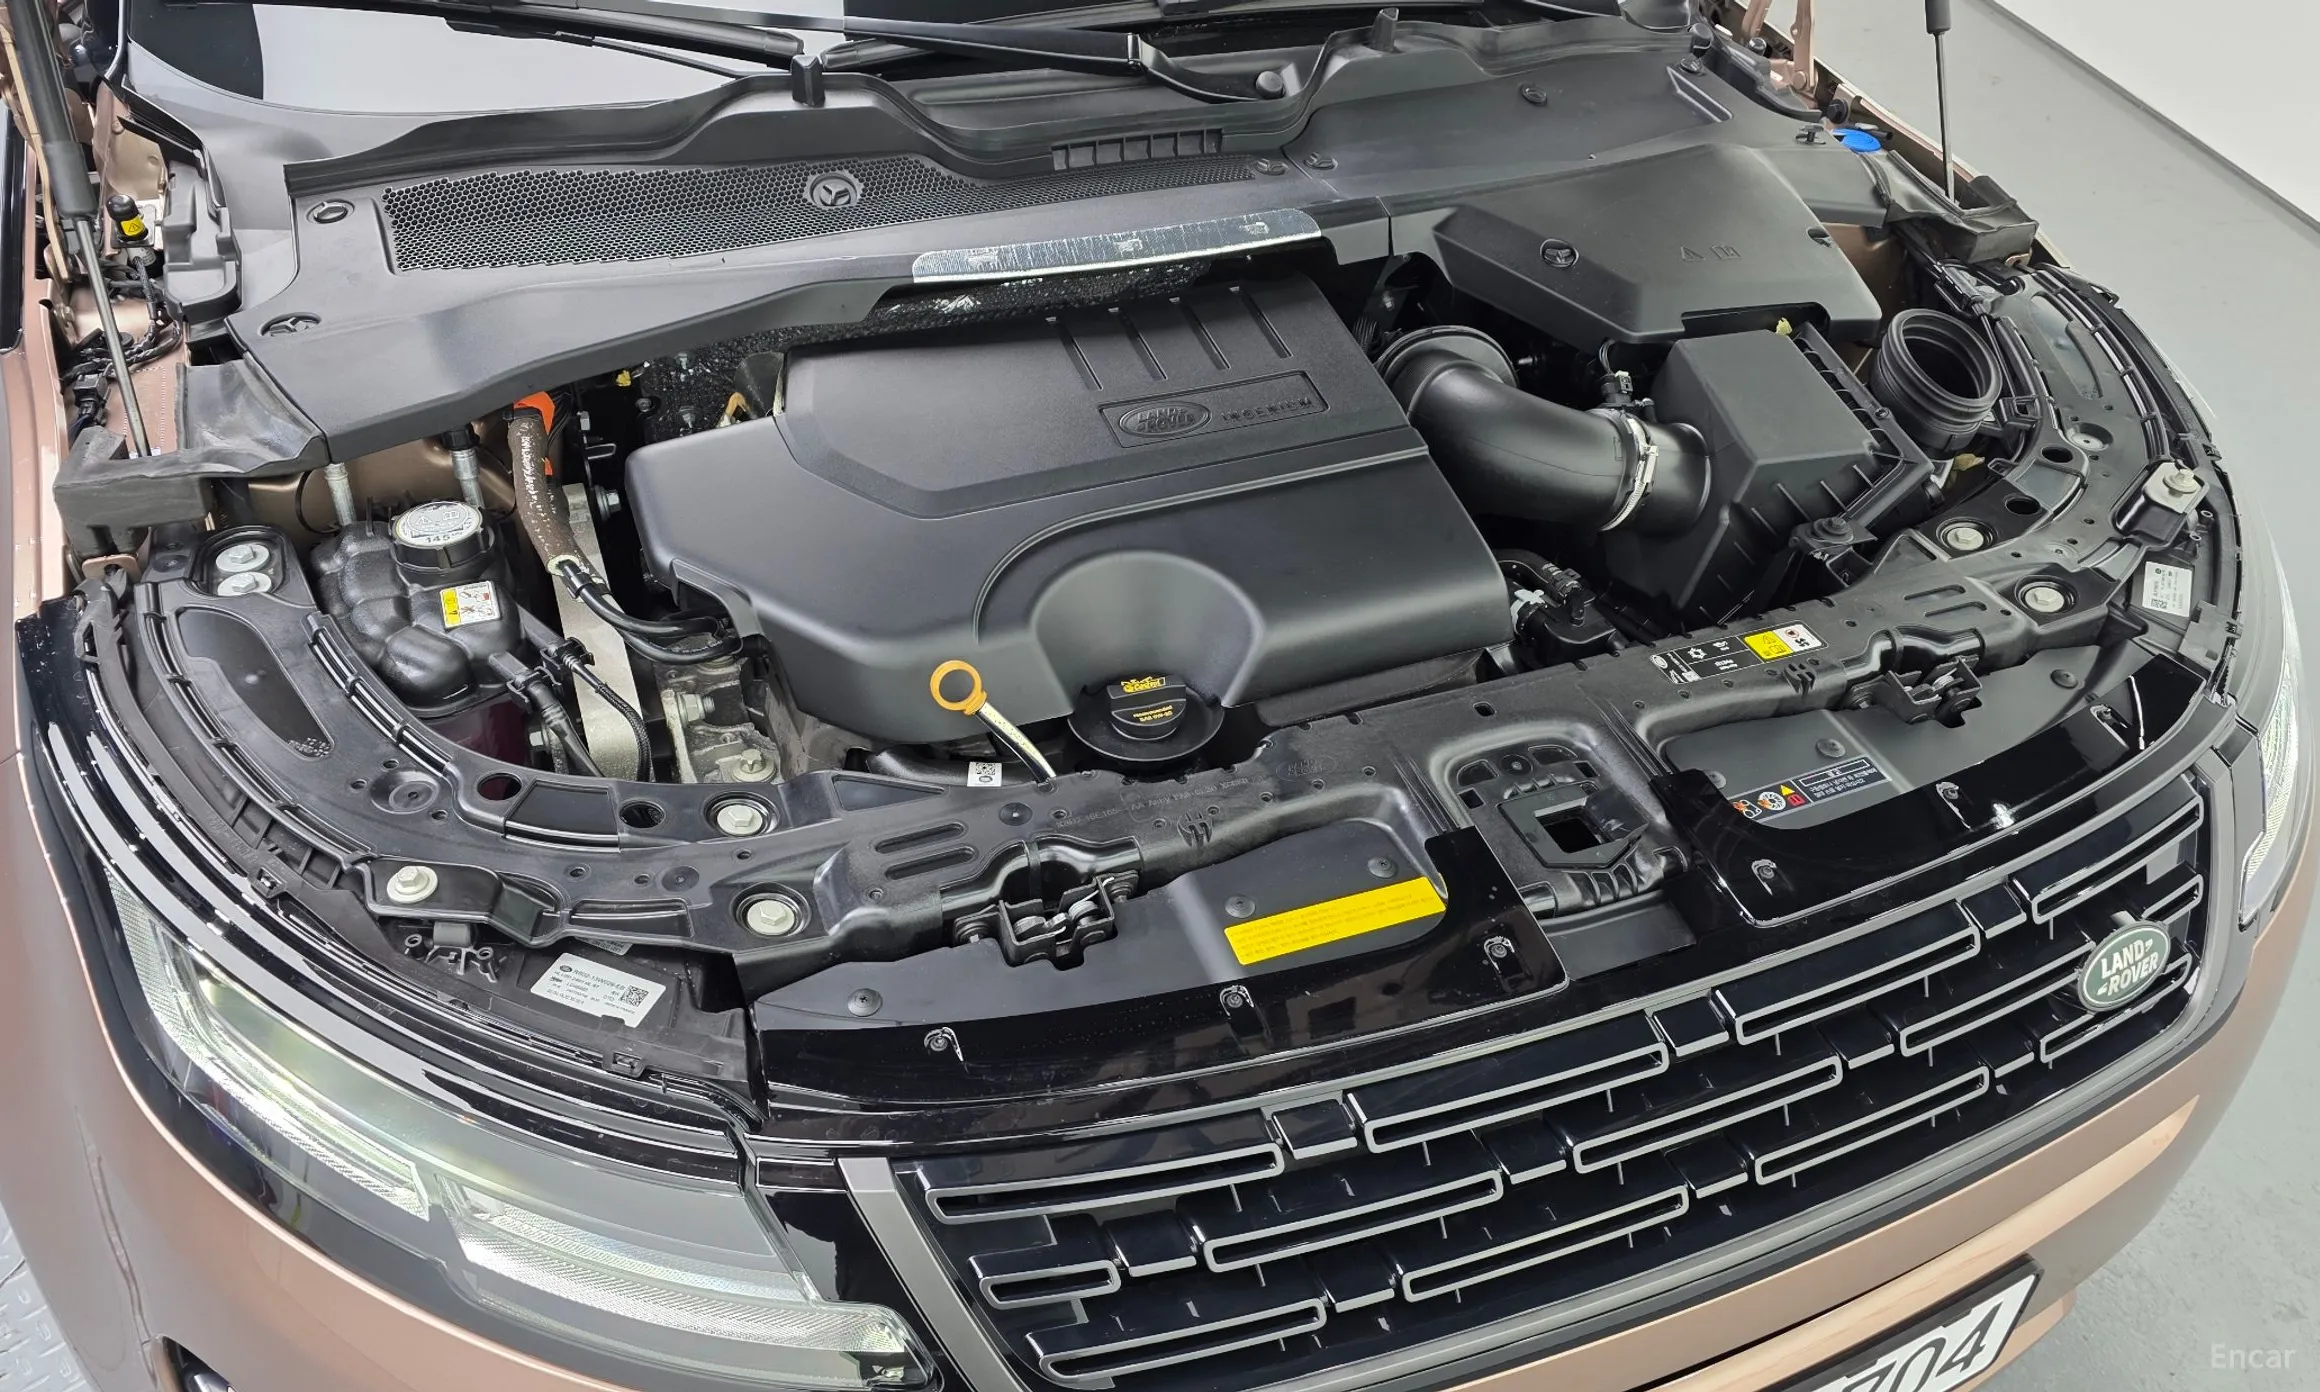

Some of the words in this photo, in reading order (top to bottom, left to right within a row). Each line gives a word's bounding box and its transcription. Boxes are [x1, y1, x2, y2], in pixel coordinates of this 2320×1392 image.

[1134, 680, 1160, 691] Castrol
[2101, 939, 2146, 979] LAND
[2107, 951, 2159, 996] ROVER
